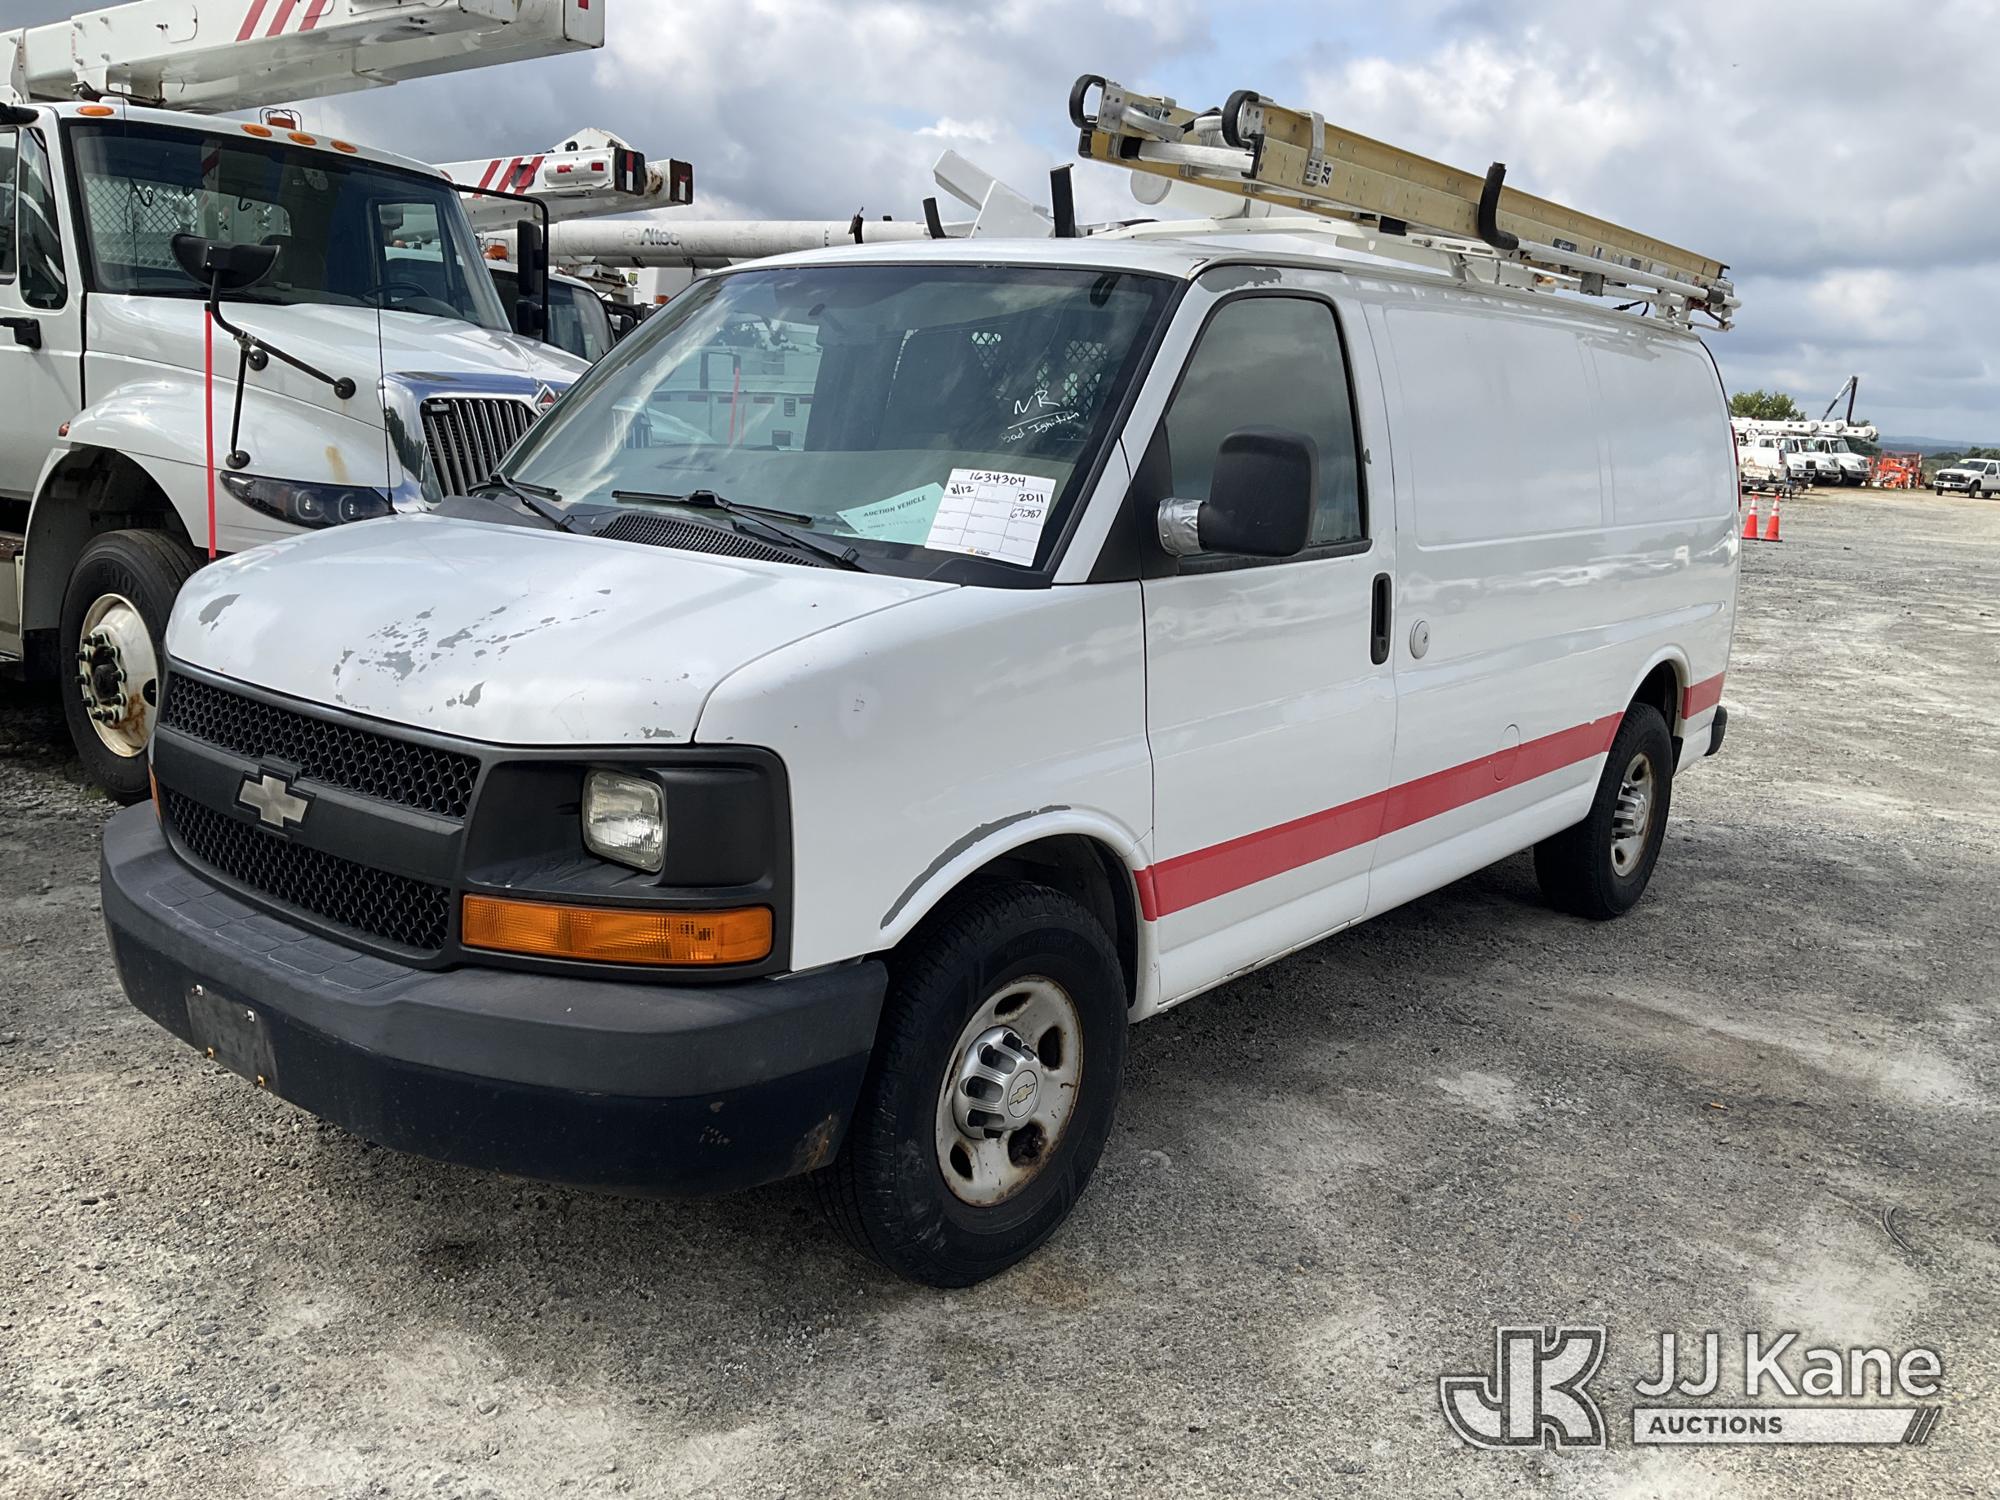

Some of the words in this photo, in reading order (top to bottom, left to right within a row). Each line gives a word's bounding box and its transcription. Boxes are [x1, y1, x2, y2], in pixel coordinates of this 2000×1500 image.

[640, 228, 680, 246] Altec
[1013, 389, 1061, 415] NR
[969, 472, 1026, 487] 1634304
[950, 484, 975, 495] 8/12
[863, 506, 896, 517] AUCTION
[897, 494, 927, 510] VEHICLE
[1018, 493, 1044, 503] 2011
